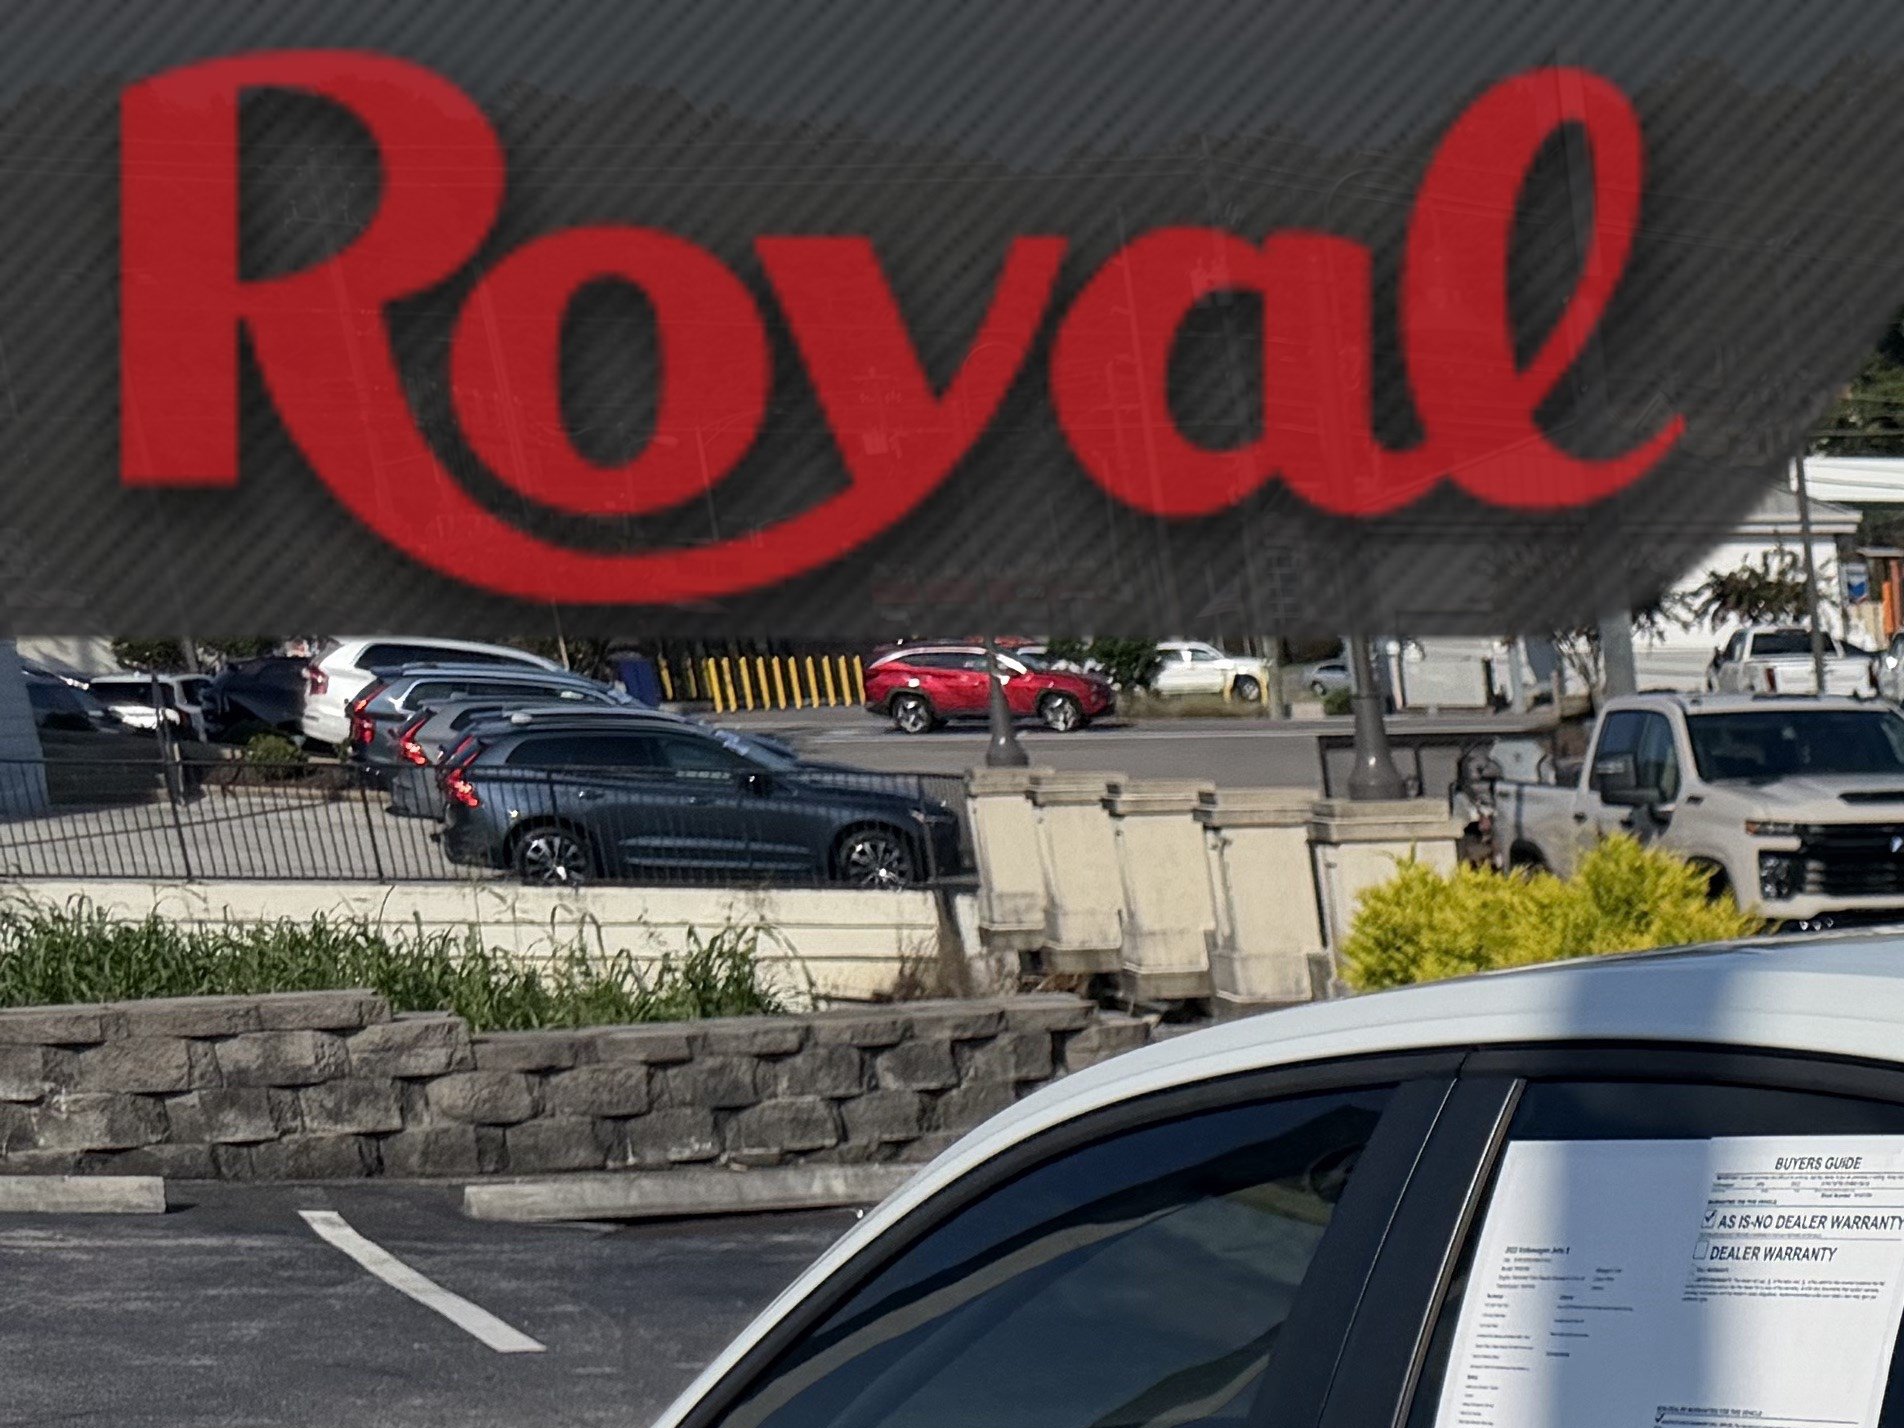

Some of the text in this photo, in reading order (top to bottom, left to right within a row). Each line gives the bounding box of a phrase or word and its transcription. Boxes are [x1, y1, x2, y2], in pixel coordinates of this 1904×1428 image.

[1774, 1156, 1863, 1170] BUYERS GUIDE
[1717, 1215, 1736, 1229] AS
[1775, 1215, 1827, 1230] DEALER
[1709, 1246, 1838, 1262] DEALER WARRANTY
